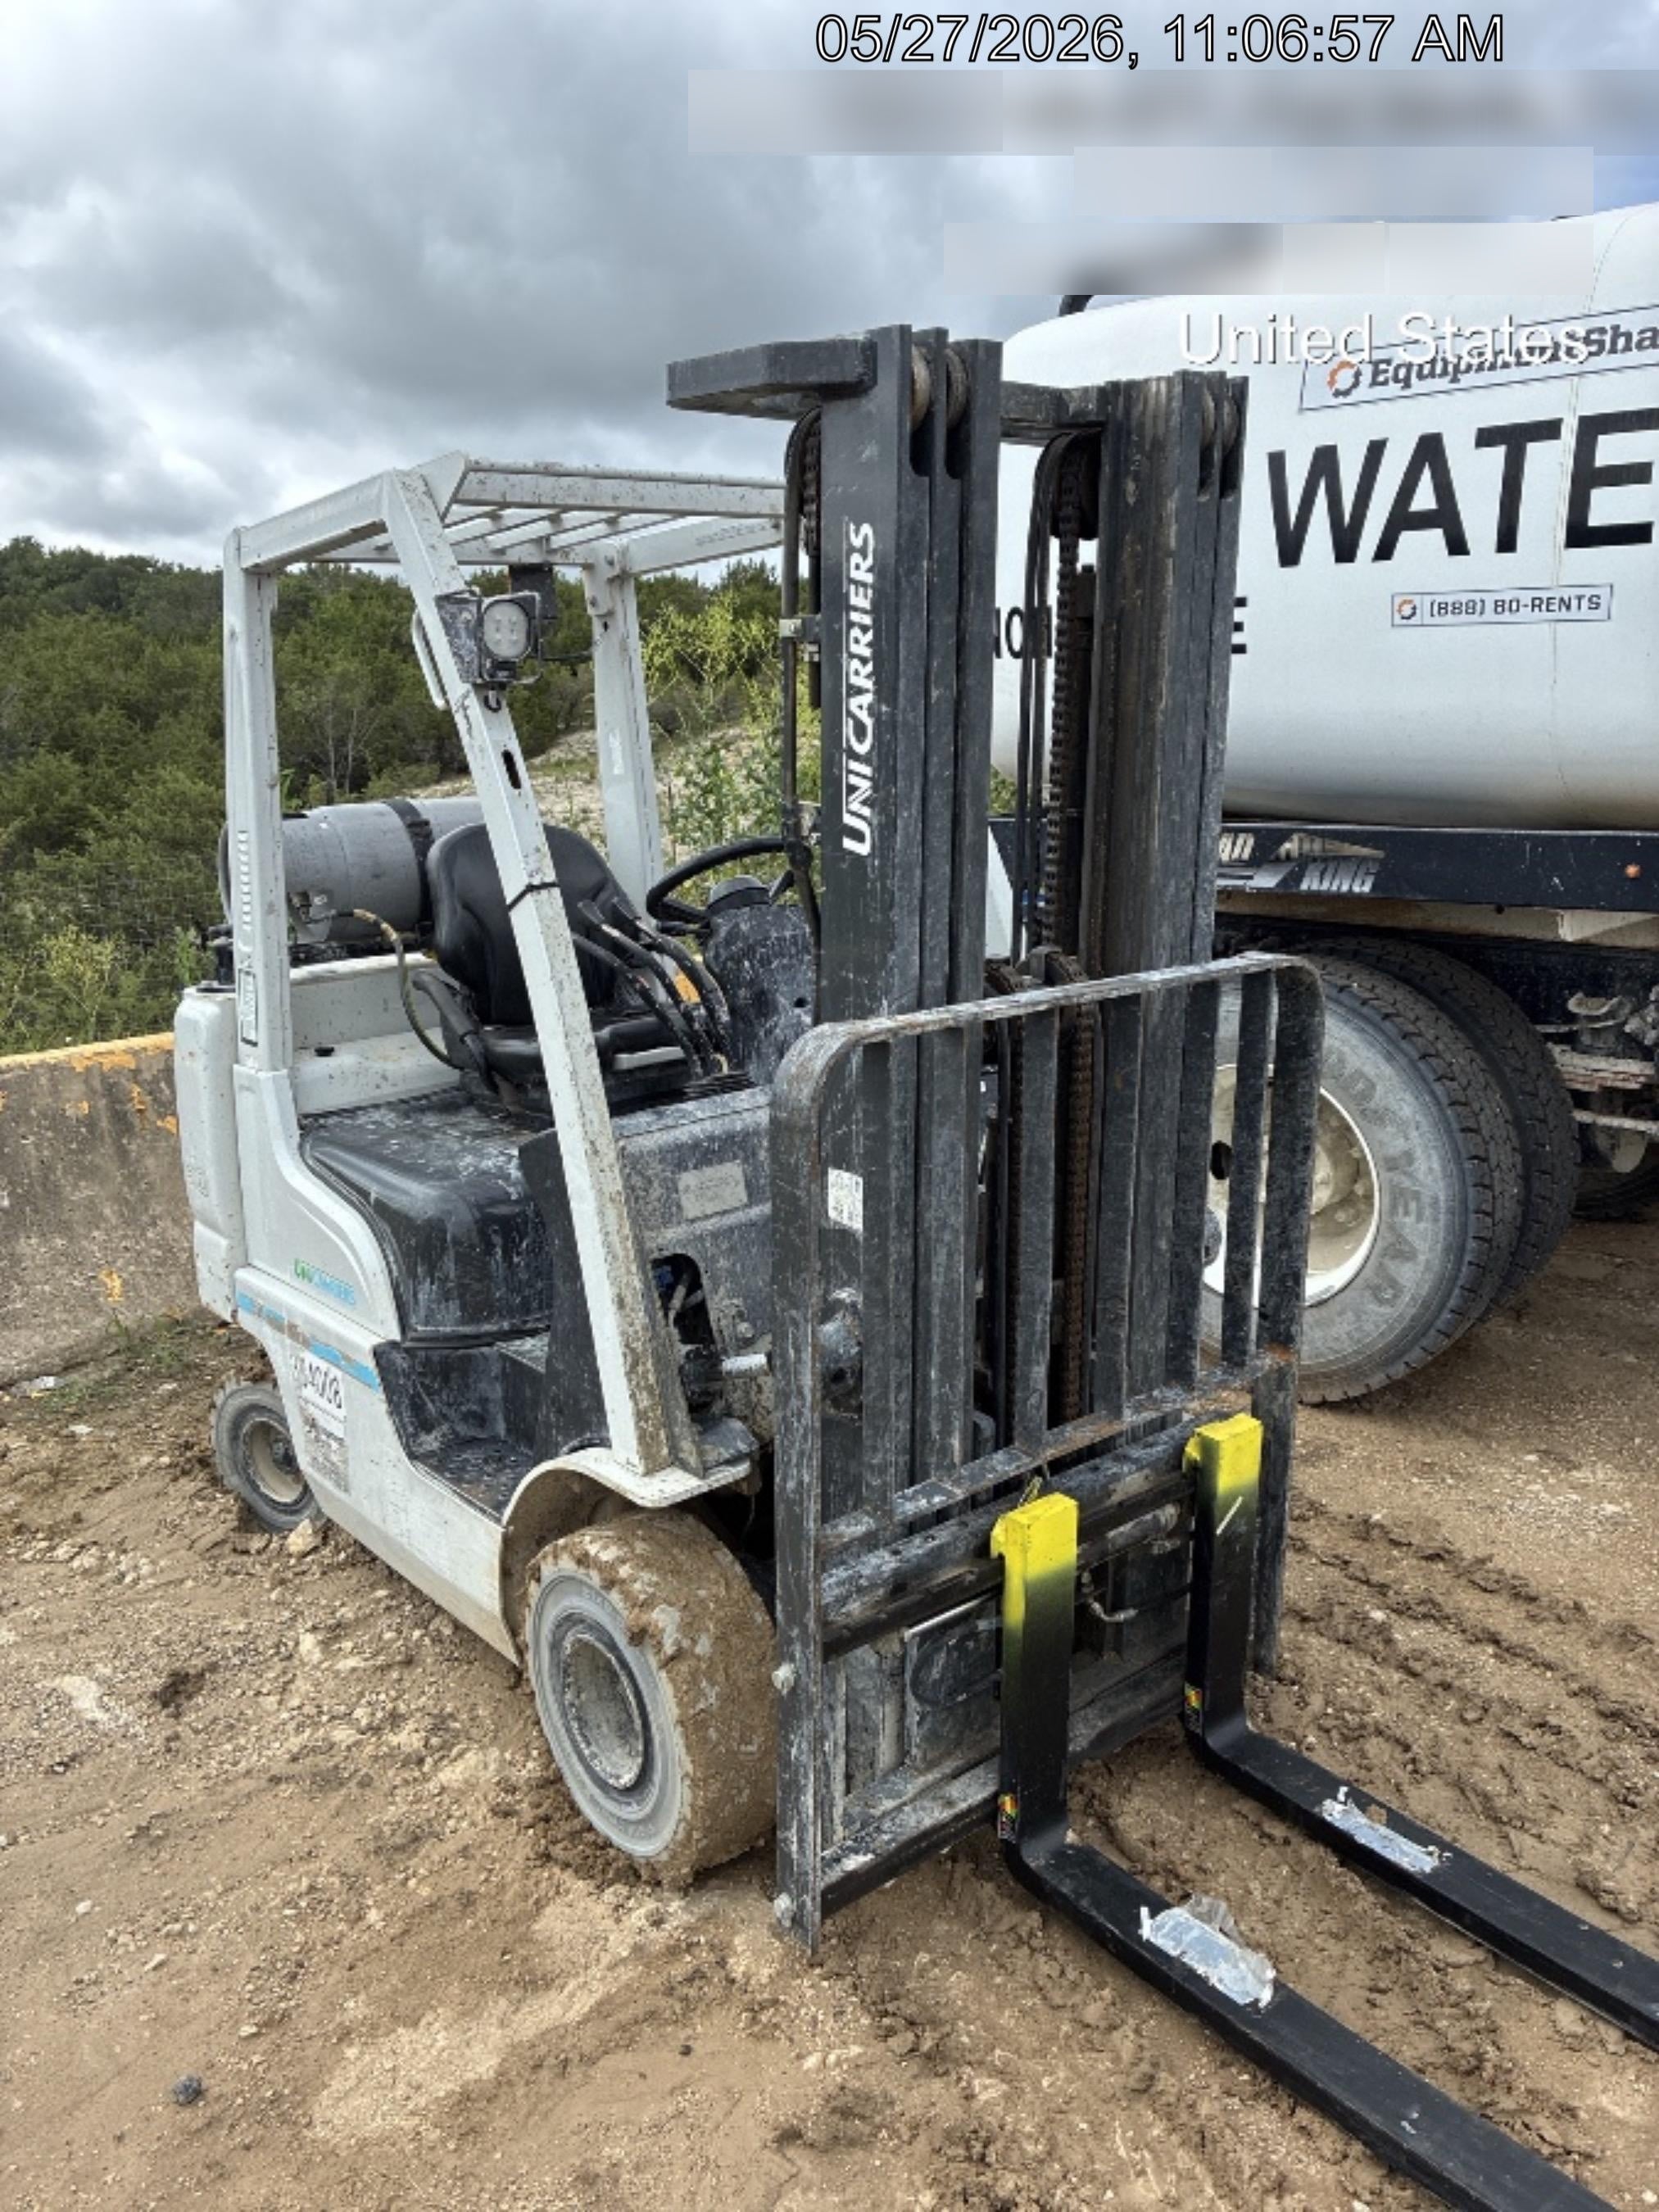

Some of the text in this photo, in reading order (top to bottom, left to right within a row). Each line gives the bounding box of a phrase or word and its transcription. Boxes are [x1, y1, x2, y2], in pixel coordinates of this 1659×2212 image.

[1430, 594, 1602, 618] (888) 80-RENTS
[843, 522, 874, 856] UNICARRIERS
[1299, 860, 1380, 893] KING
